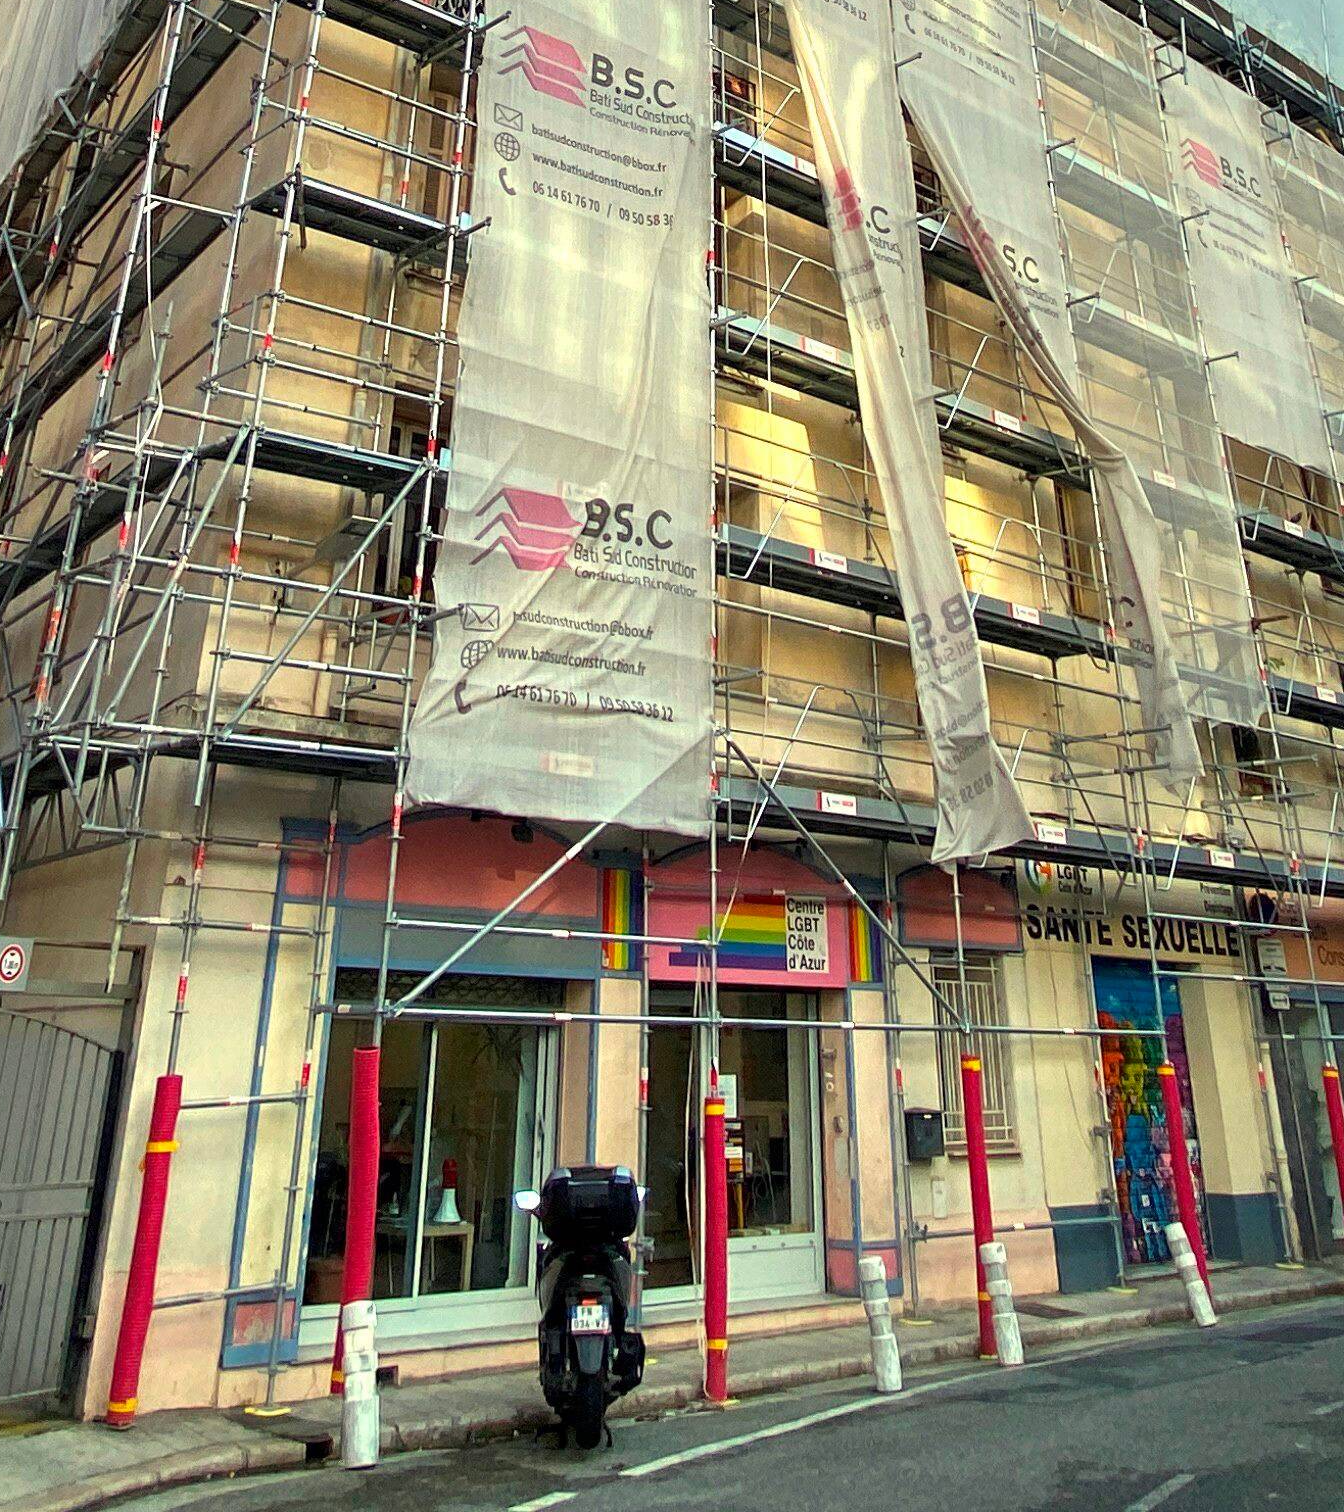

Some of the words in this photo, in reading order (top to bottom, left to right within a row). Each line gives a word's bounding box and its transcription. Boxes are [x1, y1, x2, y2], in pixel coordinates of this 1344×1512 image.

[591, 53, 677, 108] B.S.C
[589, 106, 648, 135] Construction
[590, 88, 611, 108] Bati
[613, 97, 633, 116] Sud
[635, 104, 694, 126] Construct
[532, 123, 667, 173] batisudconstruction@bbox.fr
[532, 152, 663, 198] www.batisudconstruction.fr
[1220, 155, 1261, 198] B.S.C
[532, 180, 545, 195] 06
[547, 185, 558, 199] 14
[561, 190, 572, 204] 61
[574, 194, 587, 208] 76
[588, 198, 600, 212] 70
[619, 207, 630, 221] 09
[632, 211, 644, 225] 50
[646, 214, 660, 226] 58
[582, 498, 673, 550] B.S.C
[573, 542, 599, 563] Bati
[603, 546, 622, 566] Sd
[497, 646, 646, 676] www.batisudconstruction.fr
[529, 685, 543, 702] 61
[546, 689, 561, 705] 76
[562, 690, 577, 707] 70
[599, 695, 614, 711] 09
[645, 702, 659, 718] 36
[661, 705, 674, 722] 12
[786, 897, 824, 915] Centre
[787, 916, 820, 932] LGBT
[788, 934, 816, 951] Côte
[1121, 913, 1241, 957] SEXUELLE
